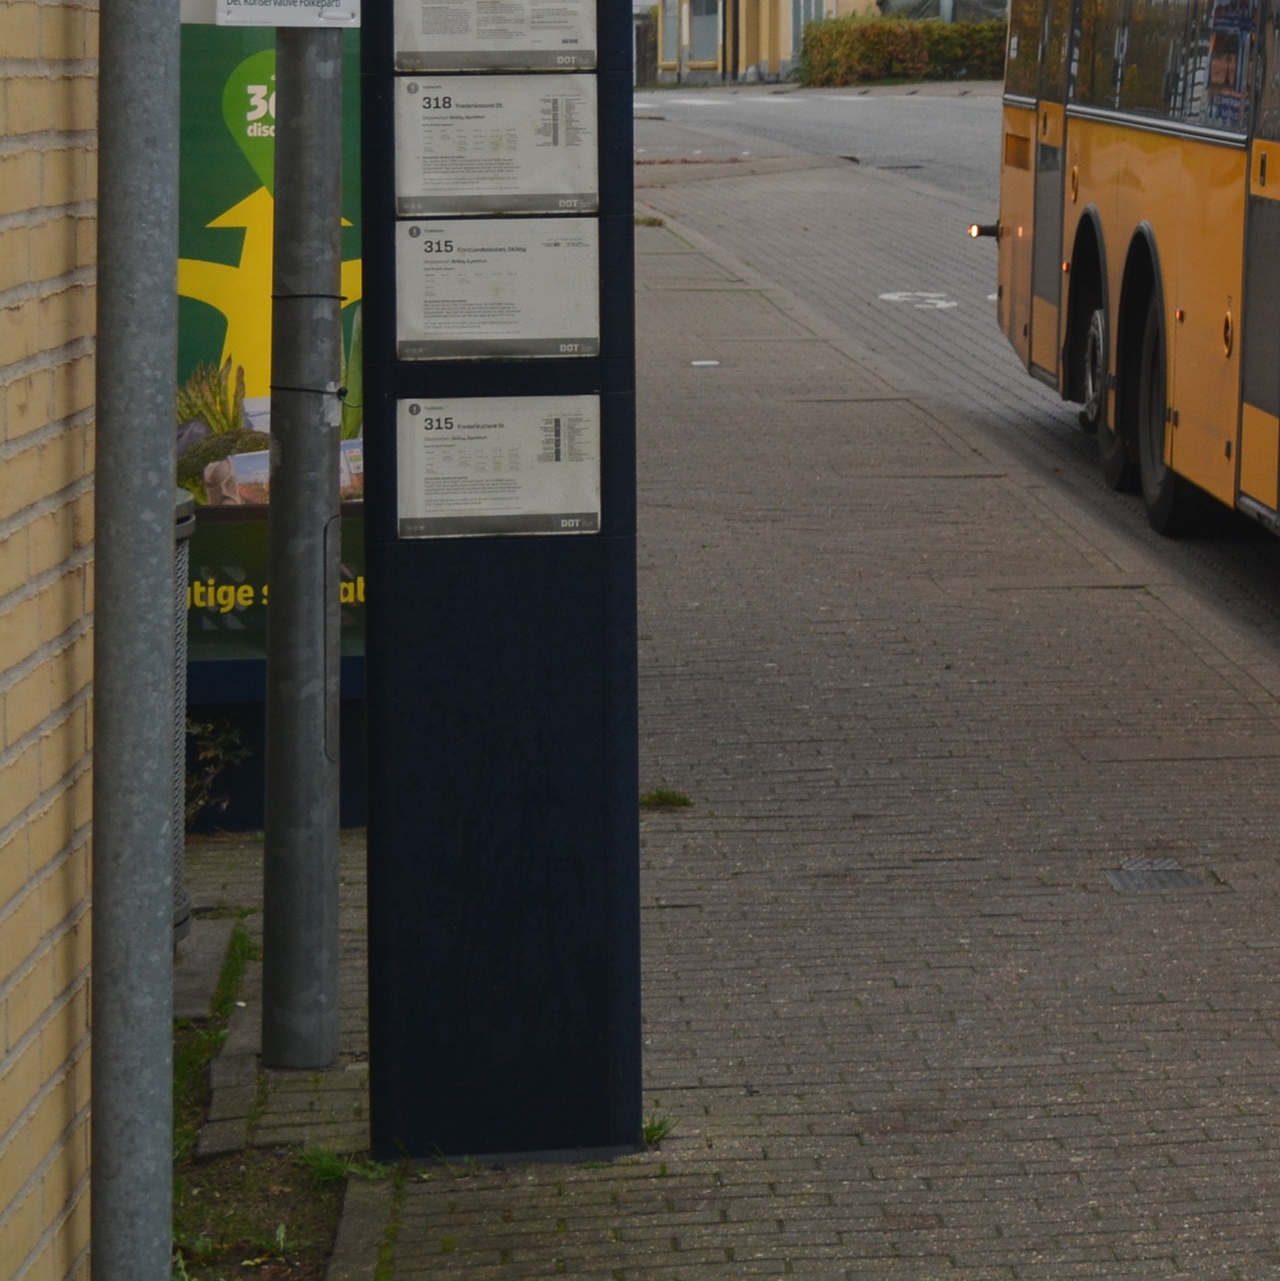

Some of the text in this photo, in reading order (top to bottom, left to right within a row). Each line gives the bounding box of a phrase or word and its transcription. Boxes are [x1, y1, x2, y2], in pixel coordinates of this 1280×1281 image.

[422, 96, 452, 109] 318
[424, 240, 453, 253] 315
[560, 344, 579, 352] DOT
[424, 417, 454, 430] 315
[561, 519, 580, 527] DOT
